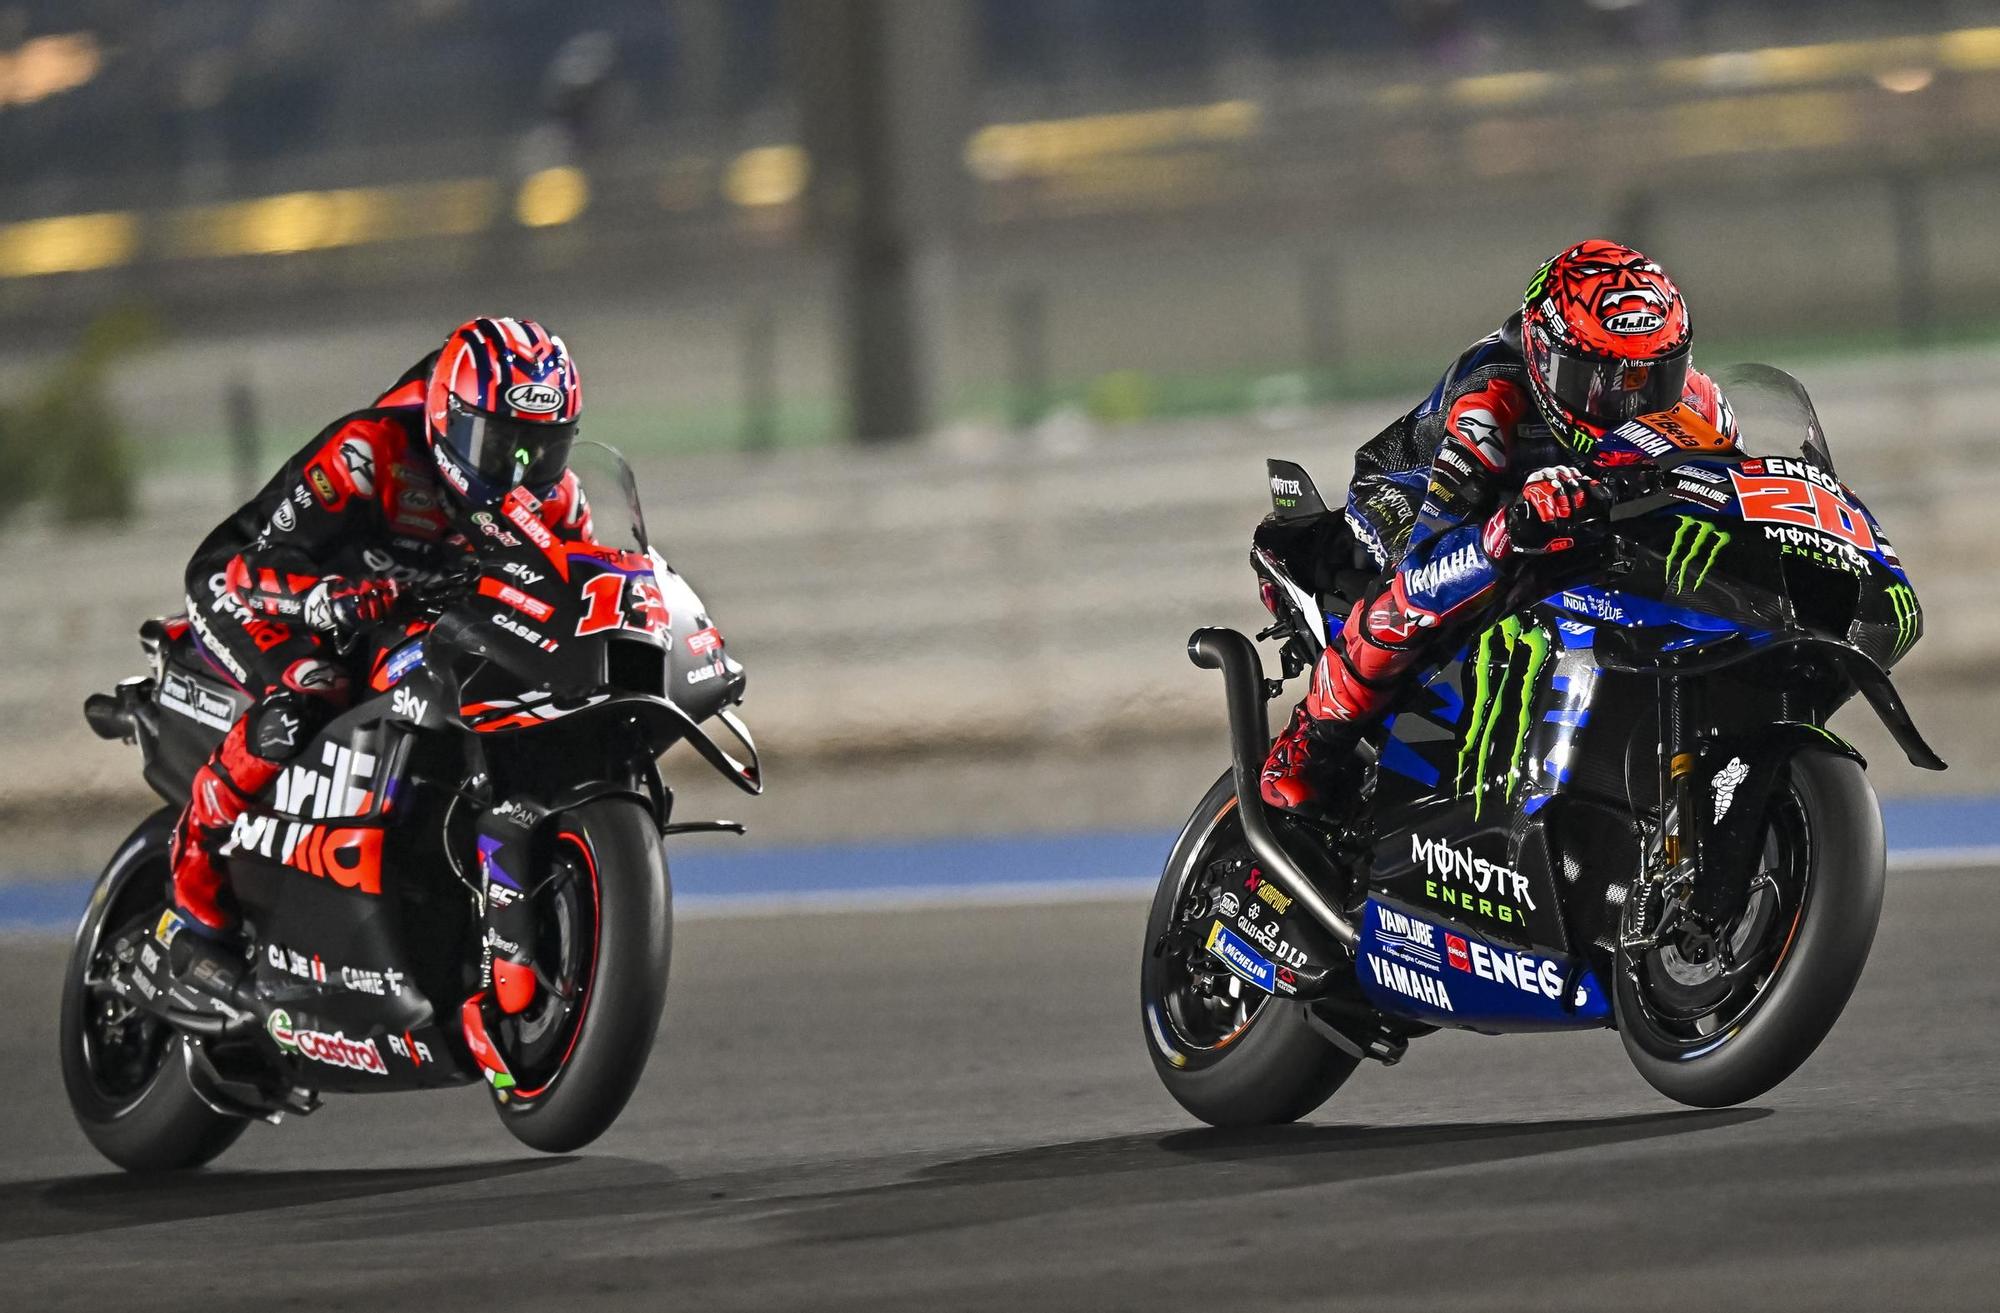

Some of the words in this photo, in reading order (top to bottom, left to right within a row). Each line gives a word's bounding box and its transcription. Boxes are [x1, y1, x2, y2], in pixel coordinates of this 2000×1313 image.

[1611, 316, 1657, 330] HJC
[516, 384, 557, 404] Arai
[1613, 420, 1673, 458] YAMAHA
[1677, 479, 1730, 504] YAMALUBE
[1421, 503, 1440, 518] NDIA
[1727, 467, 1876, 553] 20
[1764, 526, 1872, 576] MONSTER
[1782, 544, 1861, 577] ENERGY
[502, 562, 545, 585] sky
[1404, 542, 1480, 597] YAMAHA
[1563, 595, 1589, 614] INDIA
[492, 613, 542, 644] CASE
[687, 664, 716, 685] CASE
[391, 686, 428, 725] sky
[1411, 833, 1536, 910] MONSTR
[1254, 929, 1277, 953] RCB
[1377, 905, 1435, 949] YAMLUBE
[1225, 943, 1268, 980] MICHELIN
[1366, 952, 1454, 1012] YAMAHA
[295, 1030, 389, 1075] Castrol
